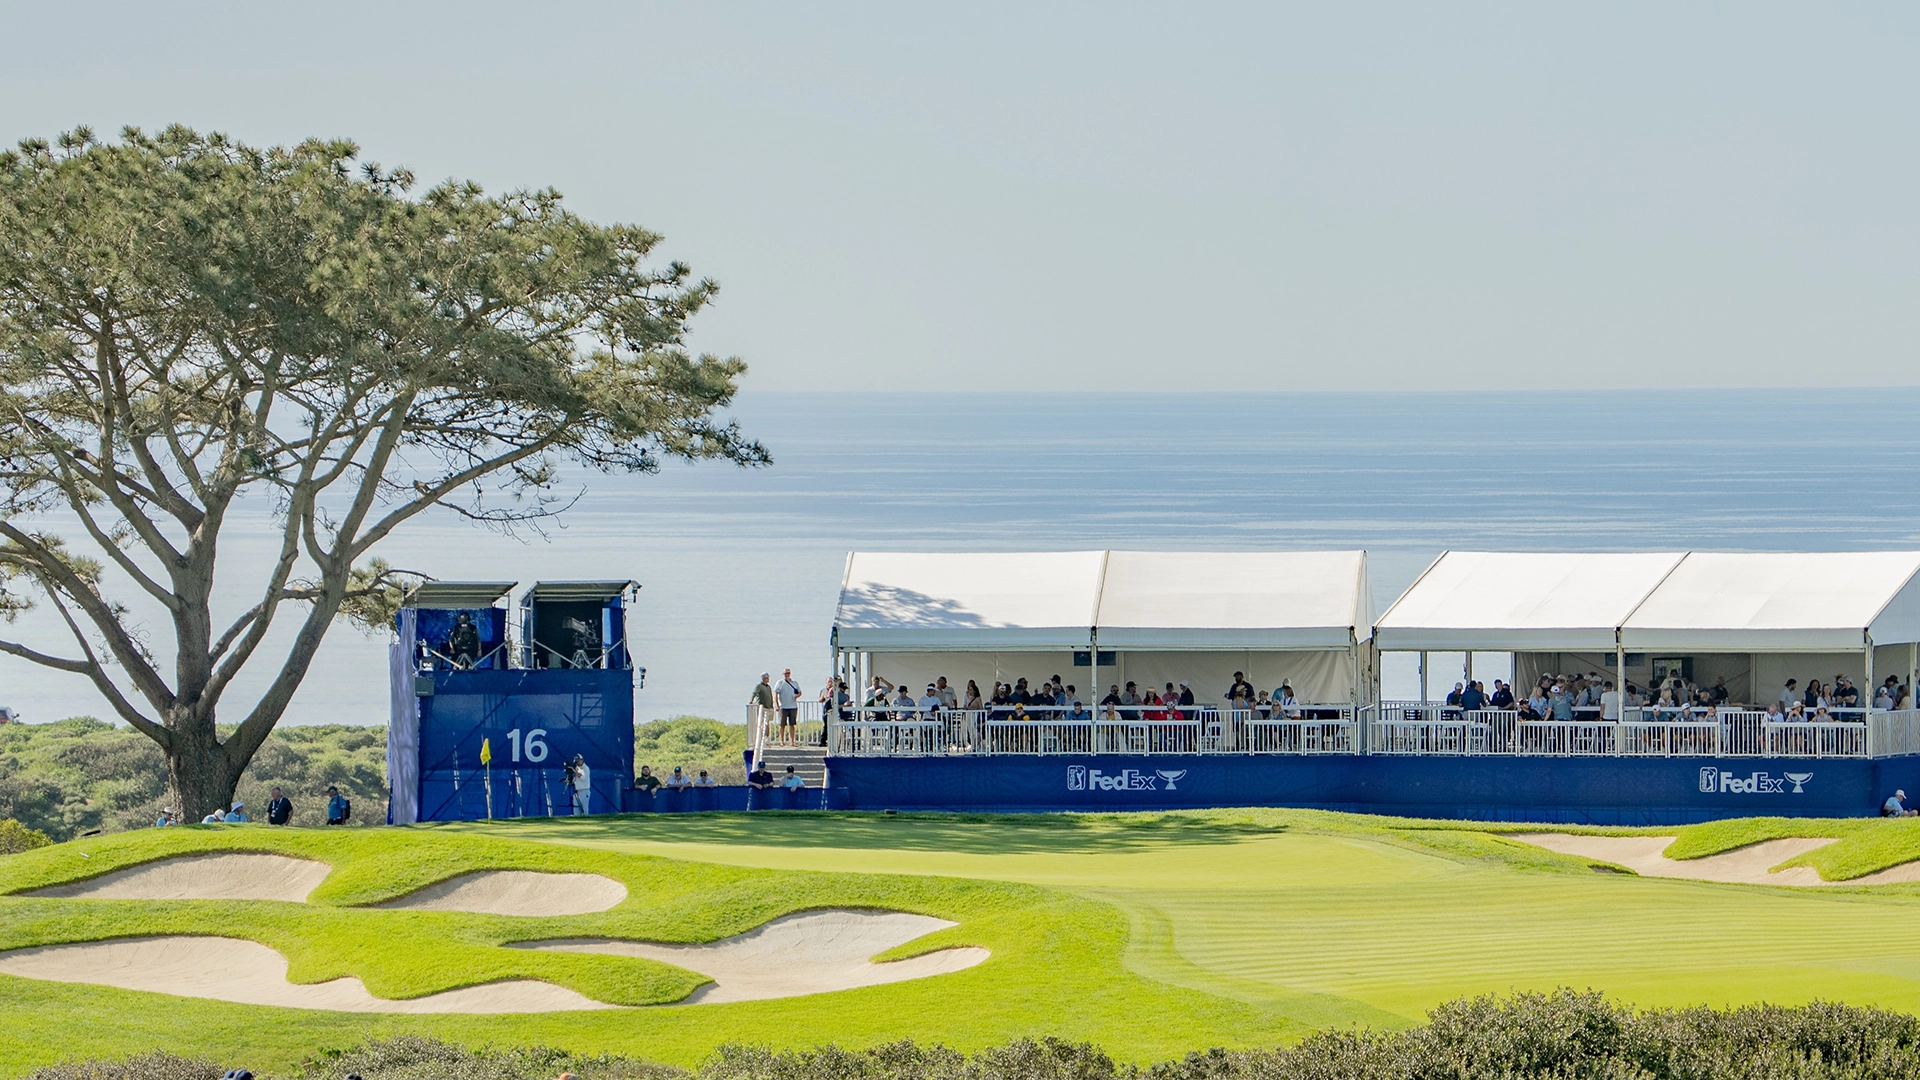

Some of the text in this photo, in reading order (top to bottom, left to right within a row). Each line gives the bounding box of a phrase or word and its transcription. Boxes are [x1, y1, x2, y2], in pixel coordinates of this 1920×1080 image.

[506, 728, 548, 762] 16
[1089, 769, 1157, 791] FedEx
[1720, 771, 1785, 793] FedEx
